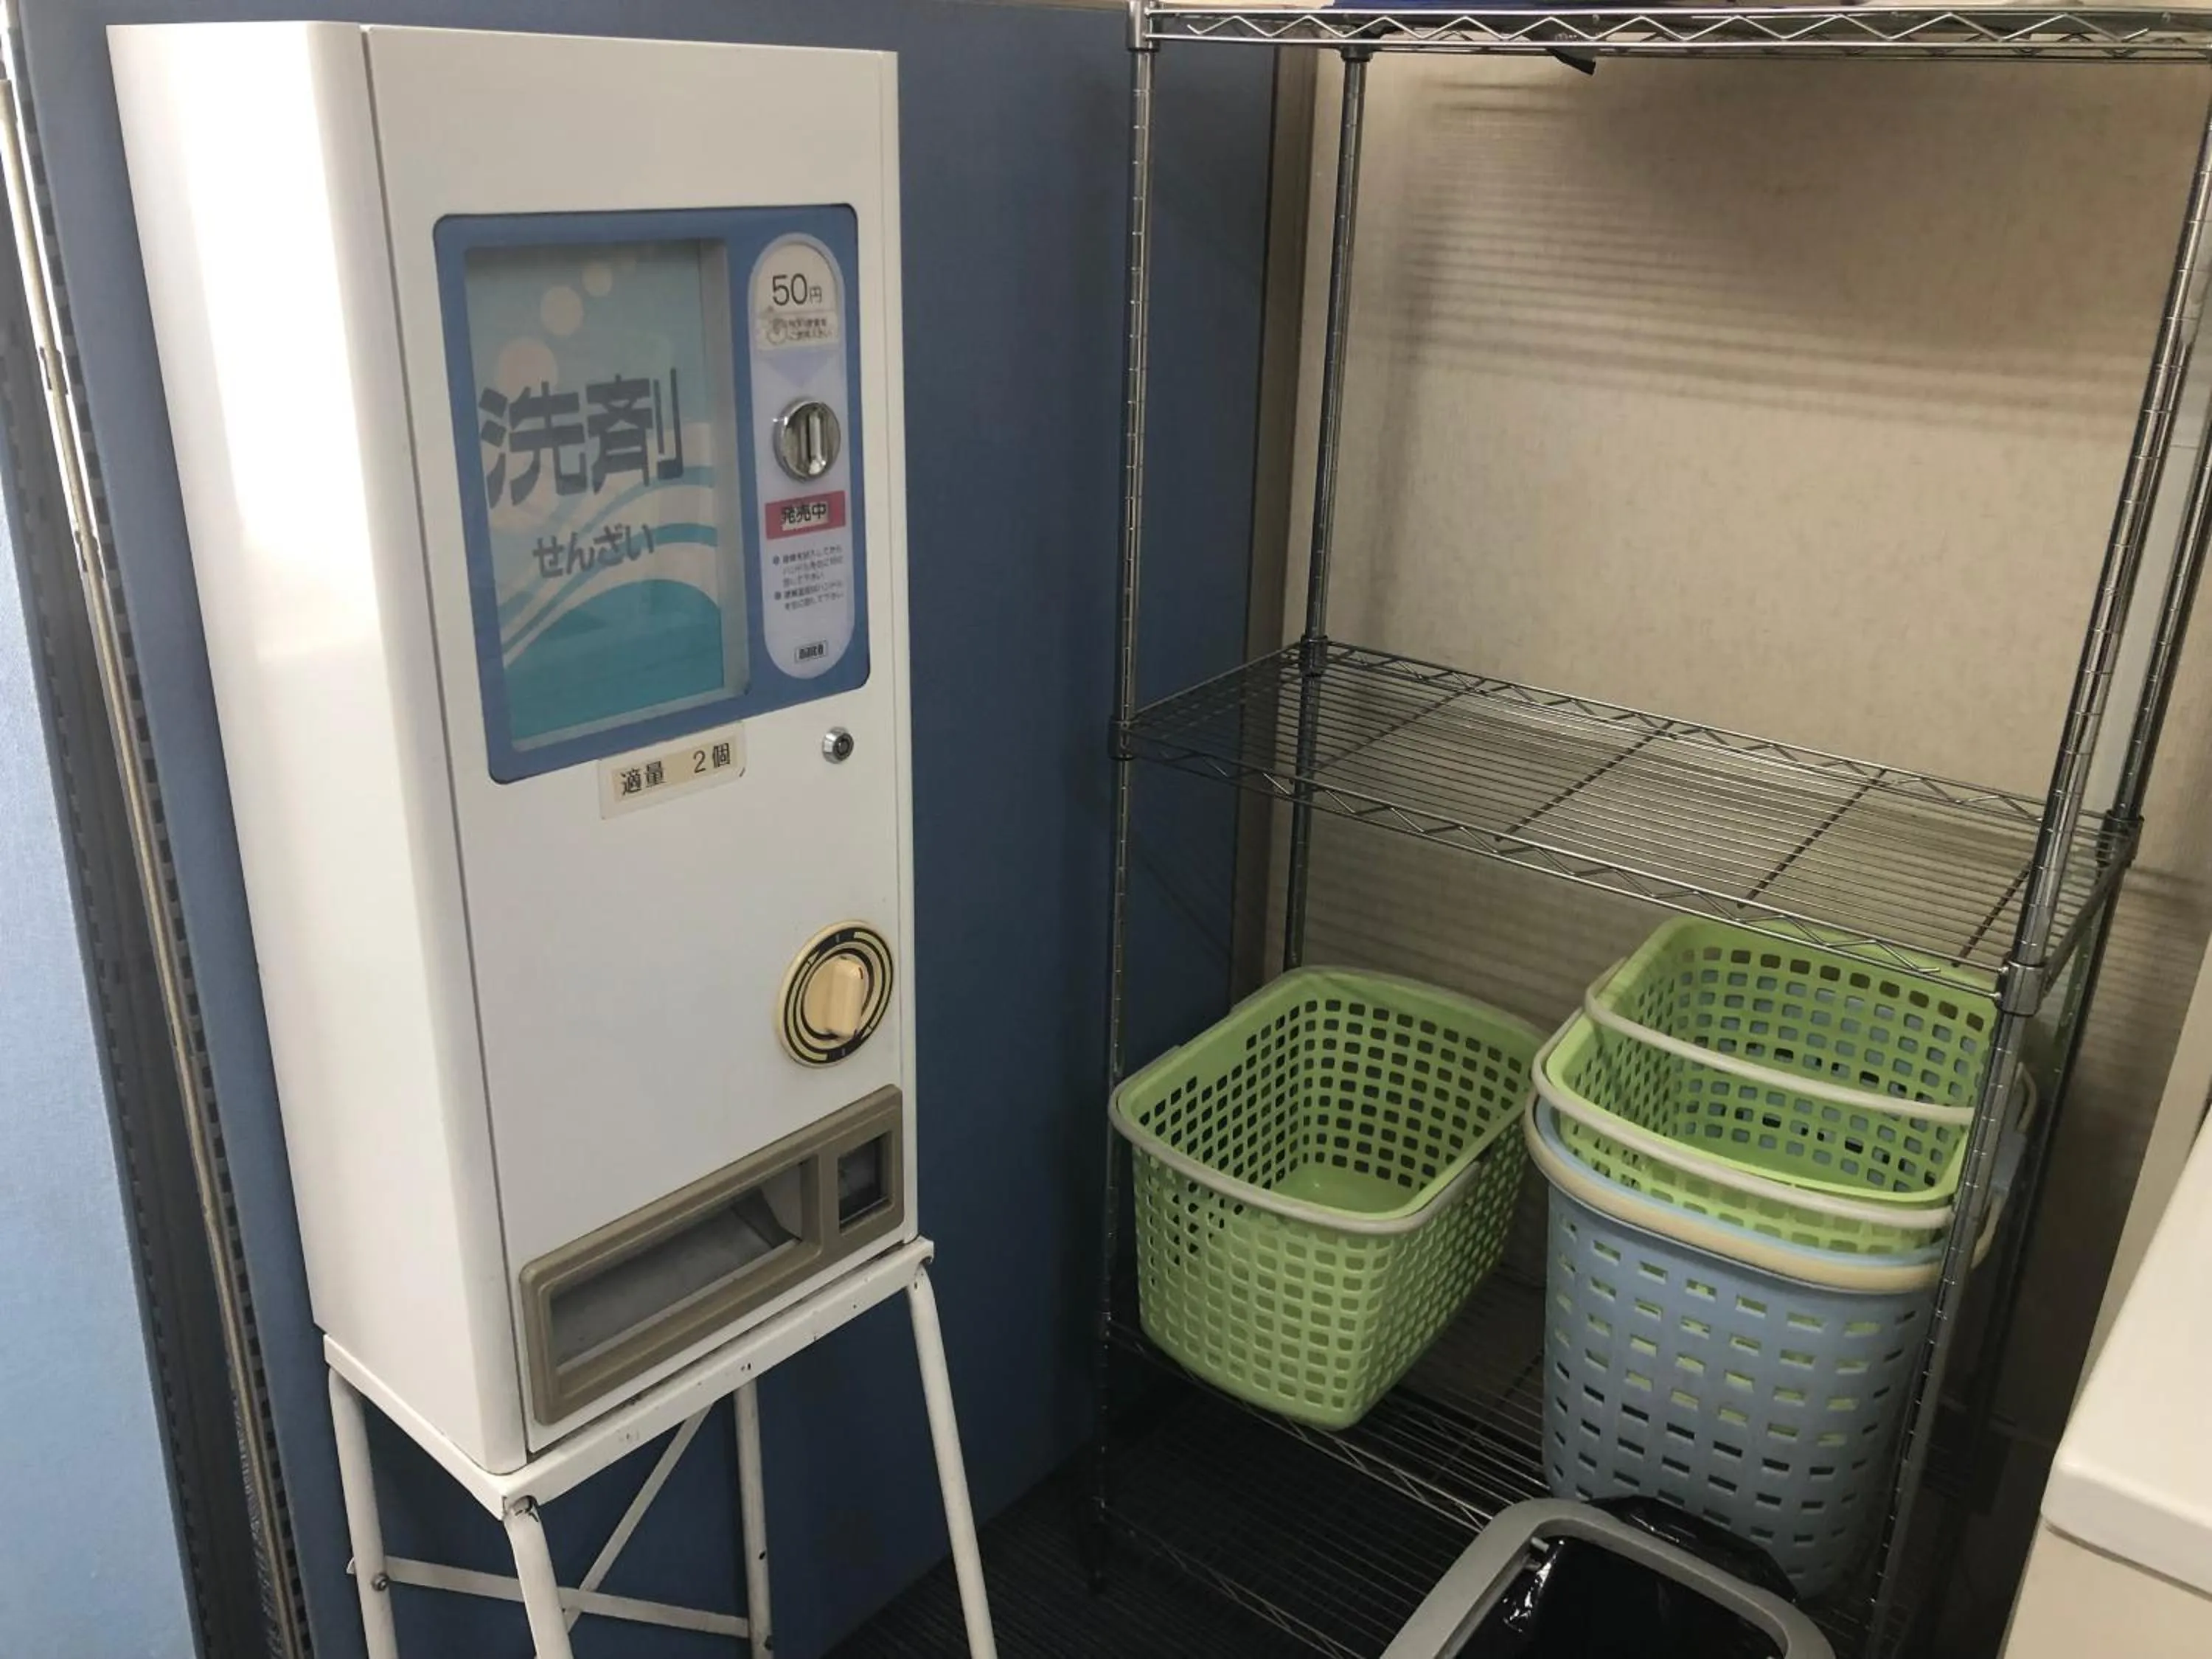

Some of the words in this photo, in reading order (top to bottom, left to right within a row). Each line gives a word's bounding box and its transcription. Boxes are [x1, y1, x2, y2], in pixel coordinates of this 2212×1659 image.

[772, 273, 822, 306] 50円
[479, 367, 683, 509] 洗剤
[532, 524, 654, 578] せんざい
[620, 761, 665, 796] 適量
[692, 742, 731, 773] 2個
